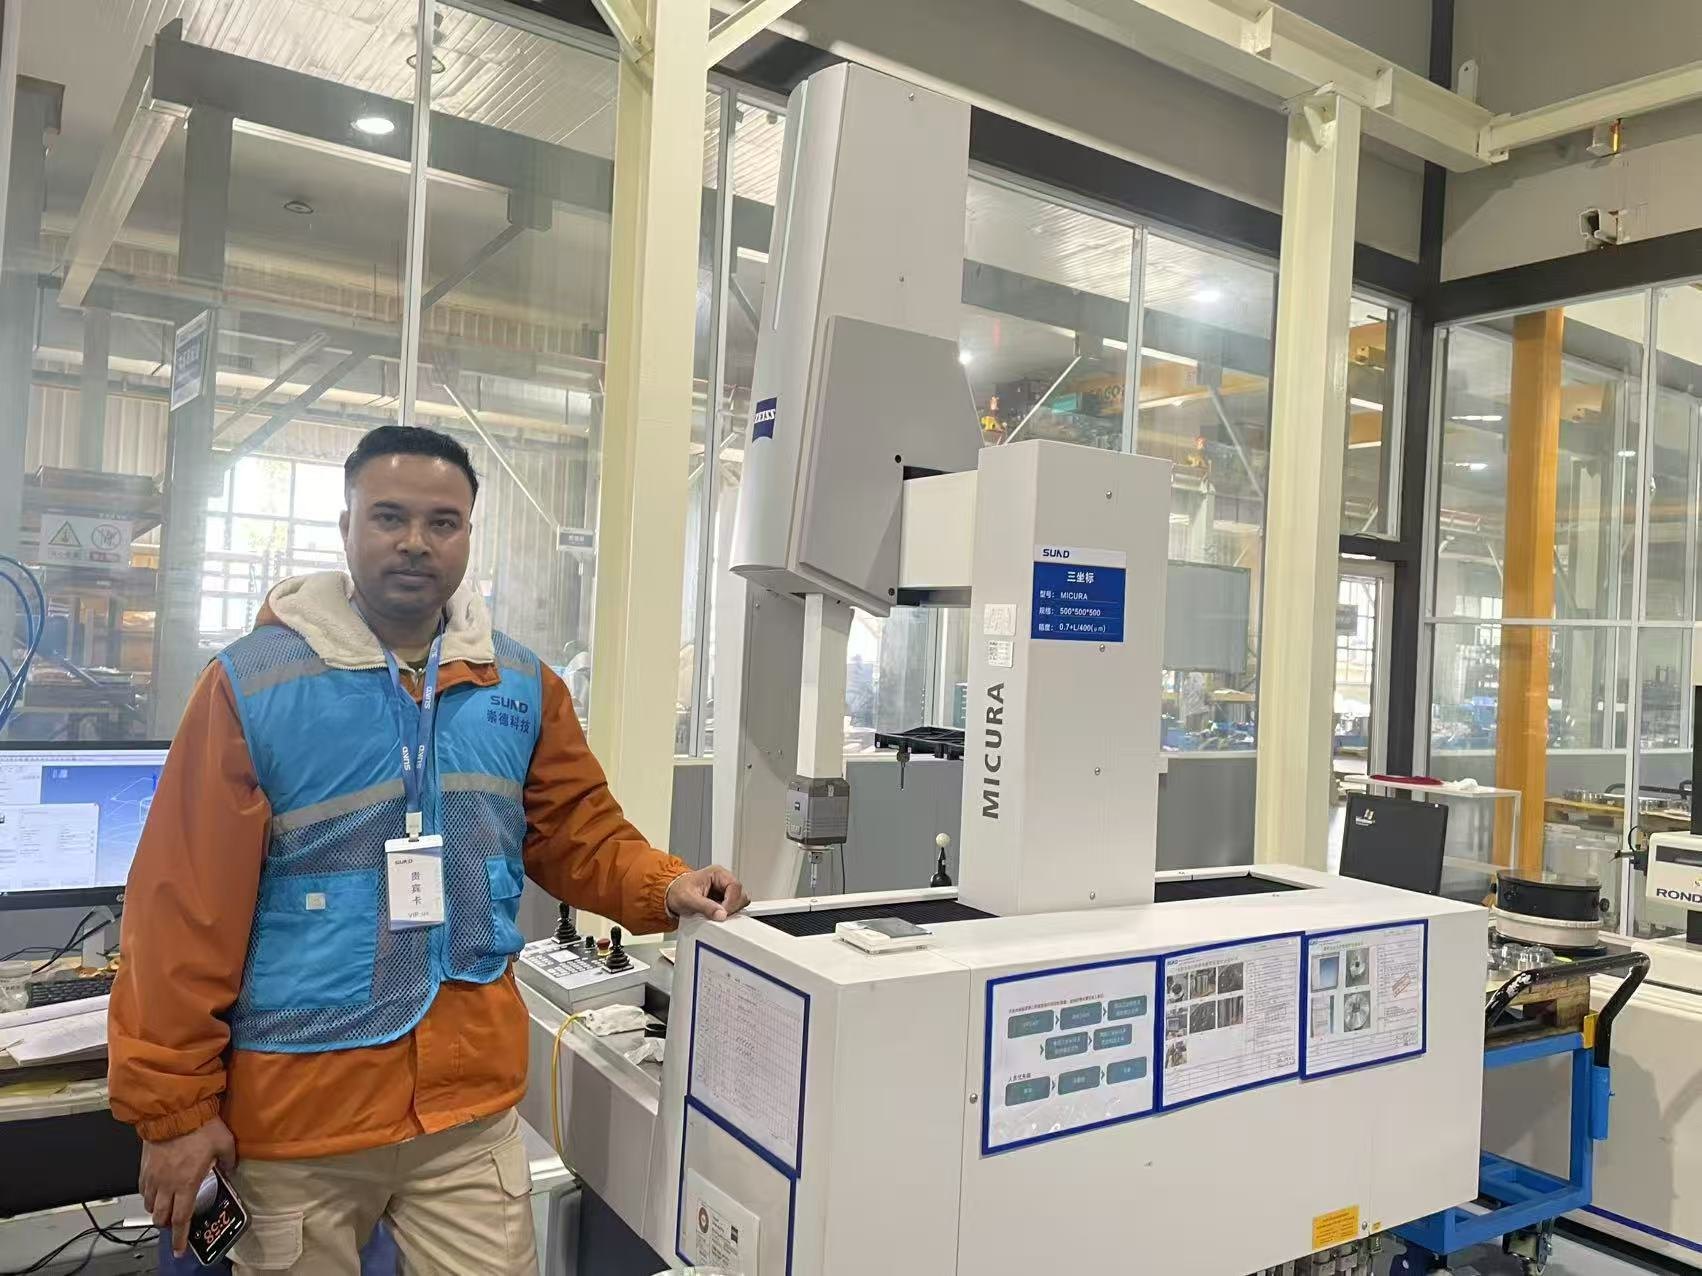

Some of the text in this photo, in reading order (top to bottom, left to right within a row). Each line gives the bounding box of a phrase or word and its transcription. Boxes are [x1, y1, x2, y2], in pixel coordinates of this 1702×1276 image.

[1067, 571, 1095, 584] 三坐标
[1060, 592, 1088, 600] MICURA
[490, 695, 529, 714] SUND
[487, 708, 531, 734] 崇德科技
[982, 682, 1005, 820] MICURA
[203, 1210, 231, 1244] 2:58
